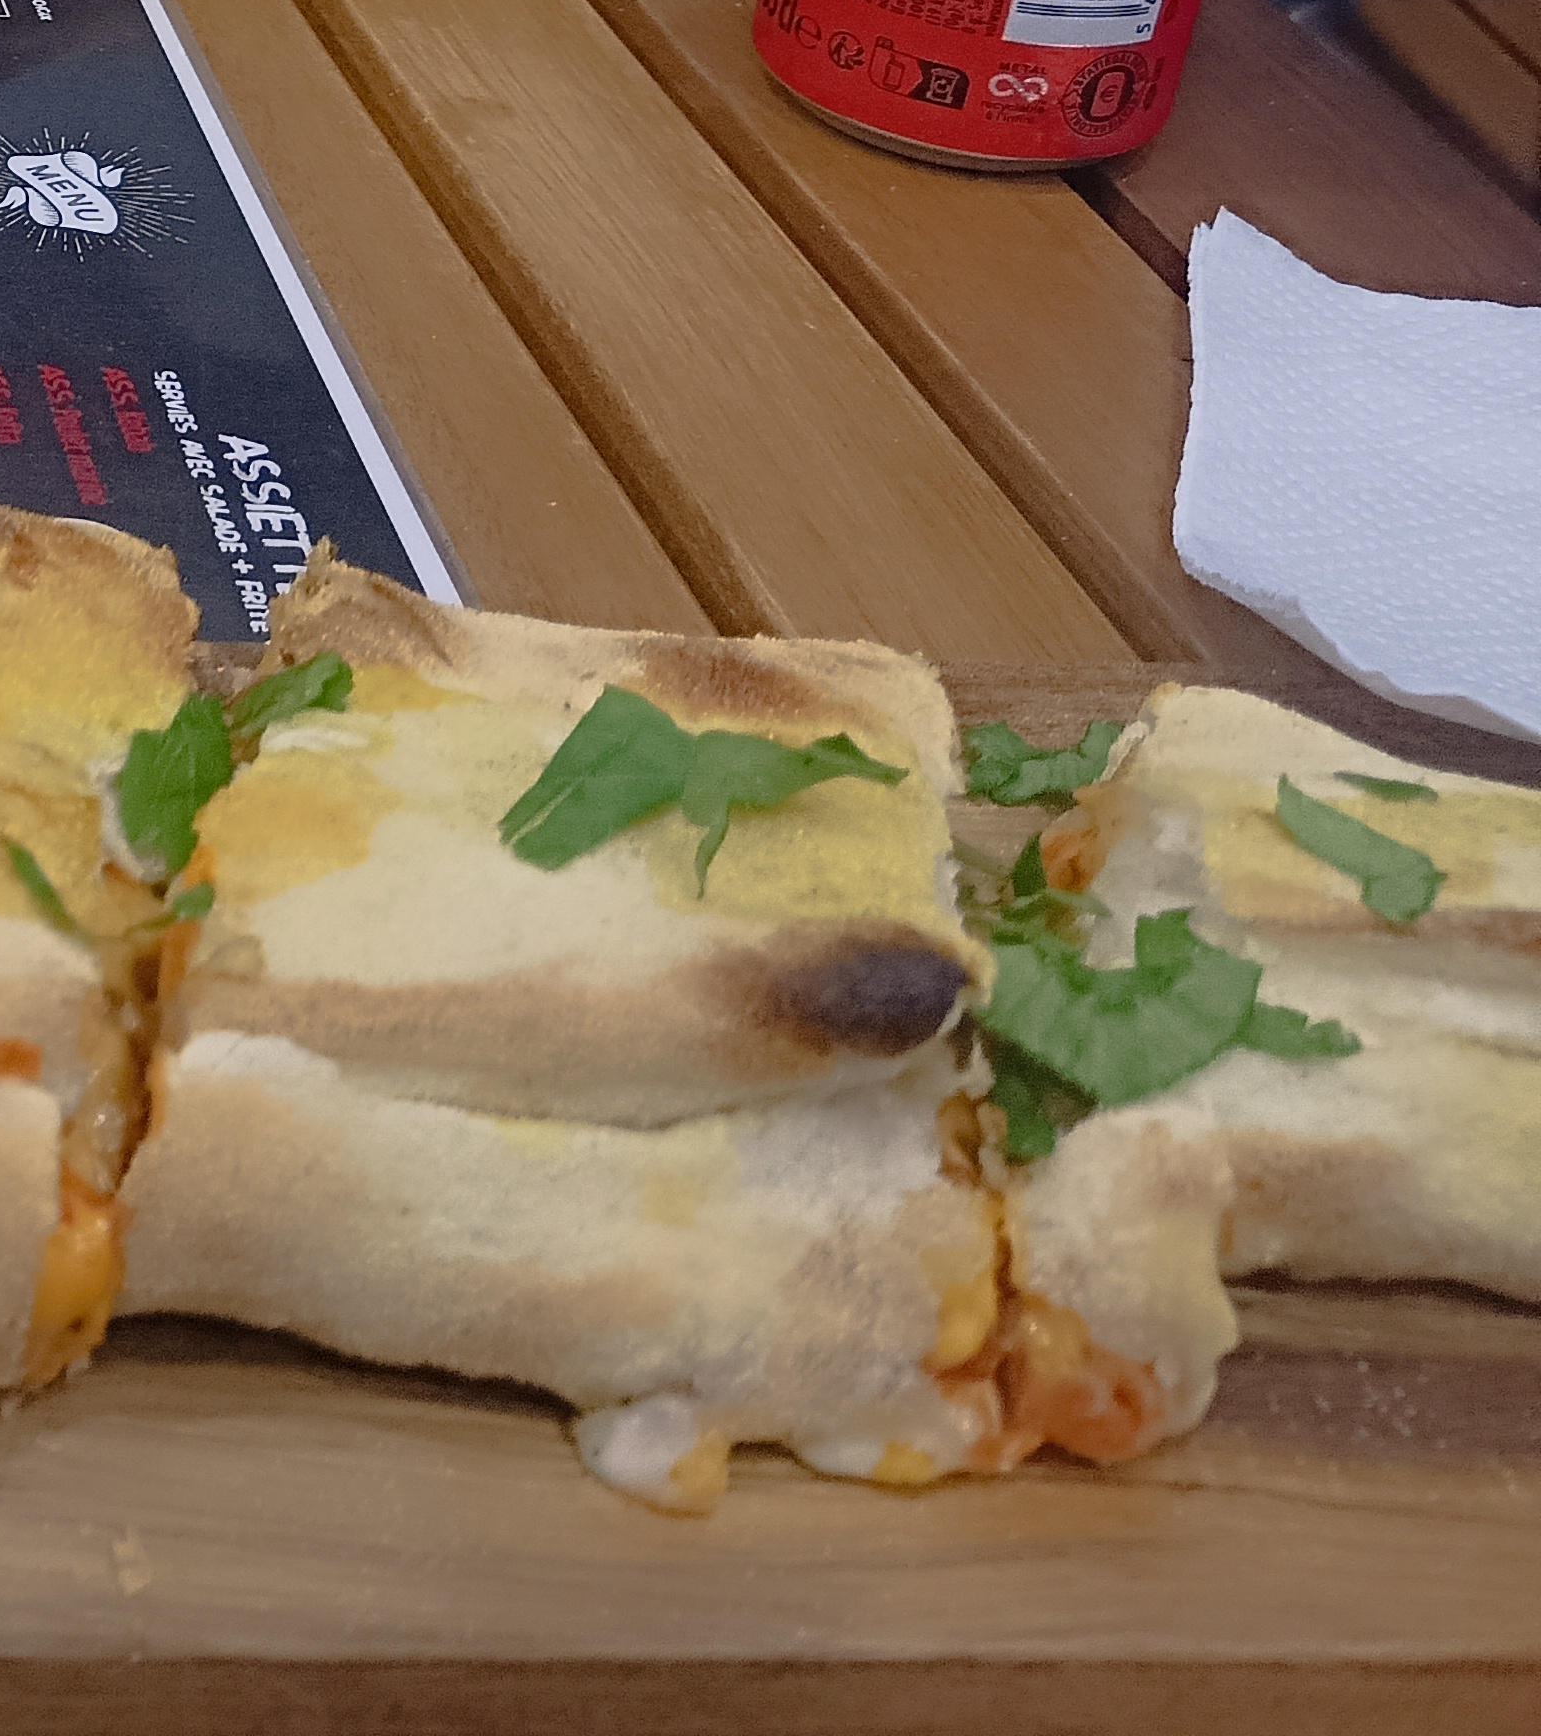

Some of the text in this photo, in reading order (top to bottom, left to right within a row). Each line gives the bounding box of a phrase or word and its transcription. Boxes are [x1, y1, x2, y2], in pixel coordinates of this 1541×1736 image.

[1136, 22, 1152, 34] 5
[24, 163, 105, 222] MENU
[153, 369, 248, 553] SERVIES AVEC SALADE
